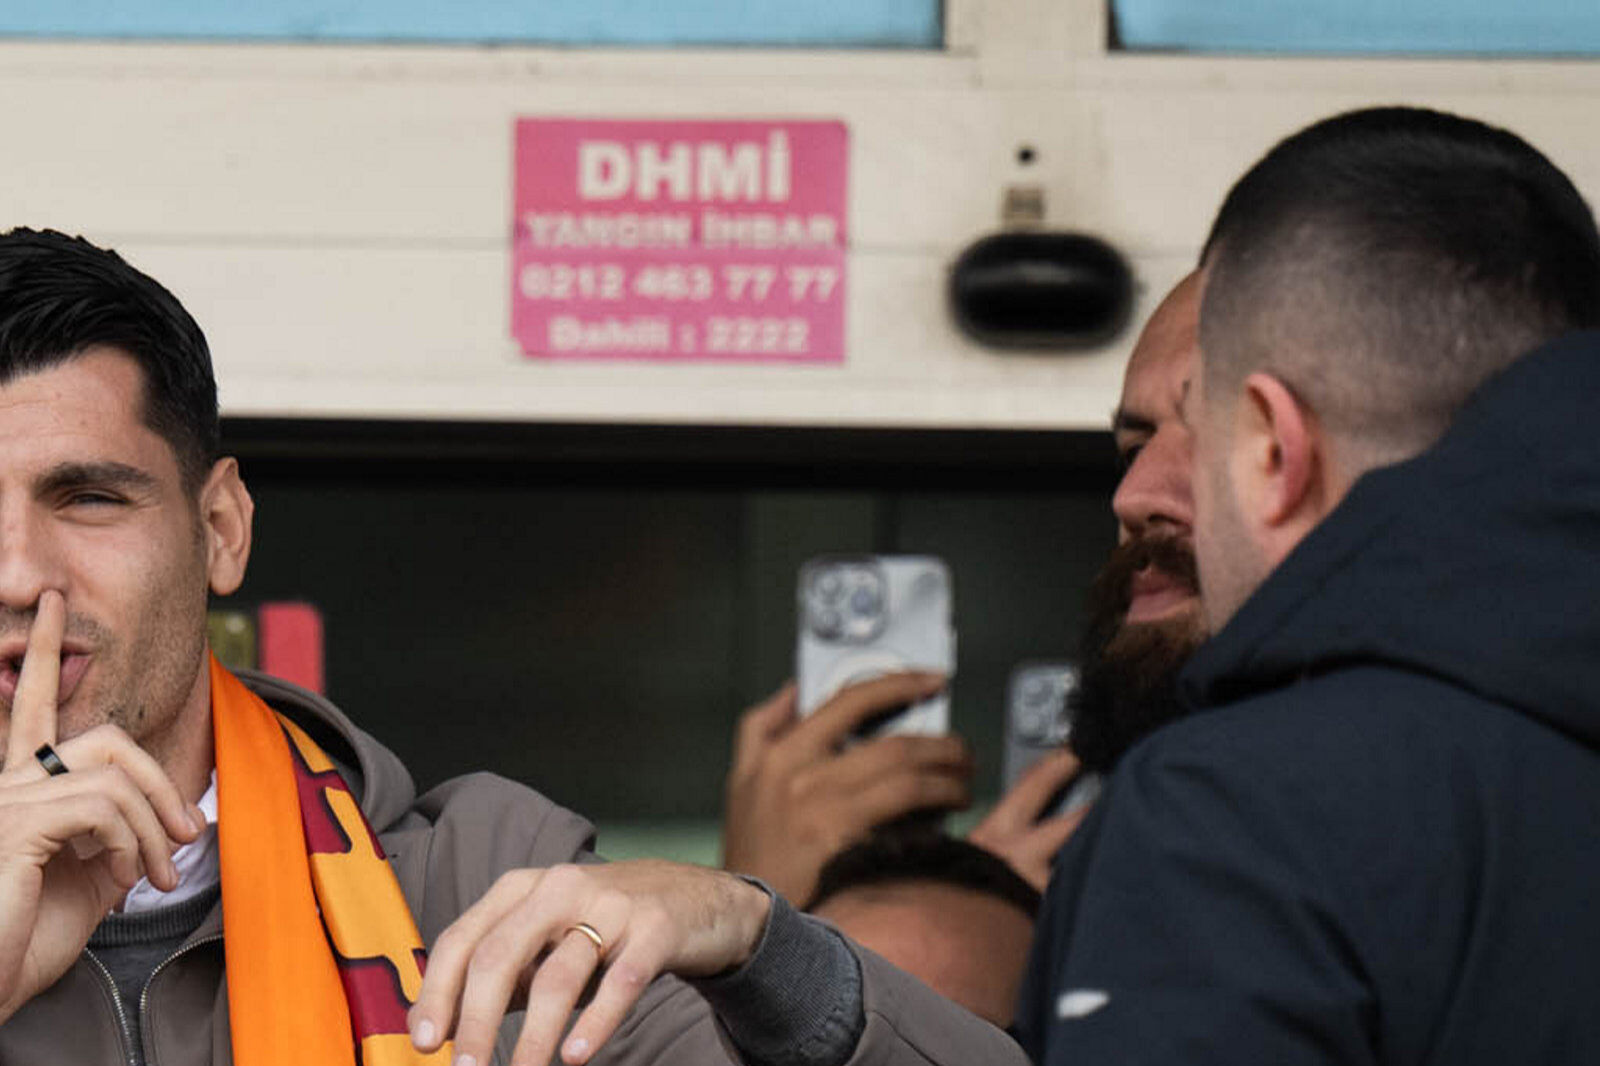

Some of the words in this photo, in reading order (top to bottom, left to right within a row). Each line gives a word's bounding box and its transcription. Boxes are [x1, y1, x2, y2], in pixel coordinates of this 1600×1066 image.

[578, 127, 792, 202] DHMİ
[520, 264, 625, 300] 0212
[724, 265, 777, 301] 77
[787, 265, 839, 301] 77
